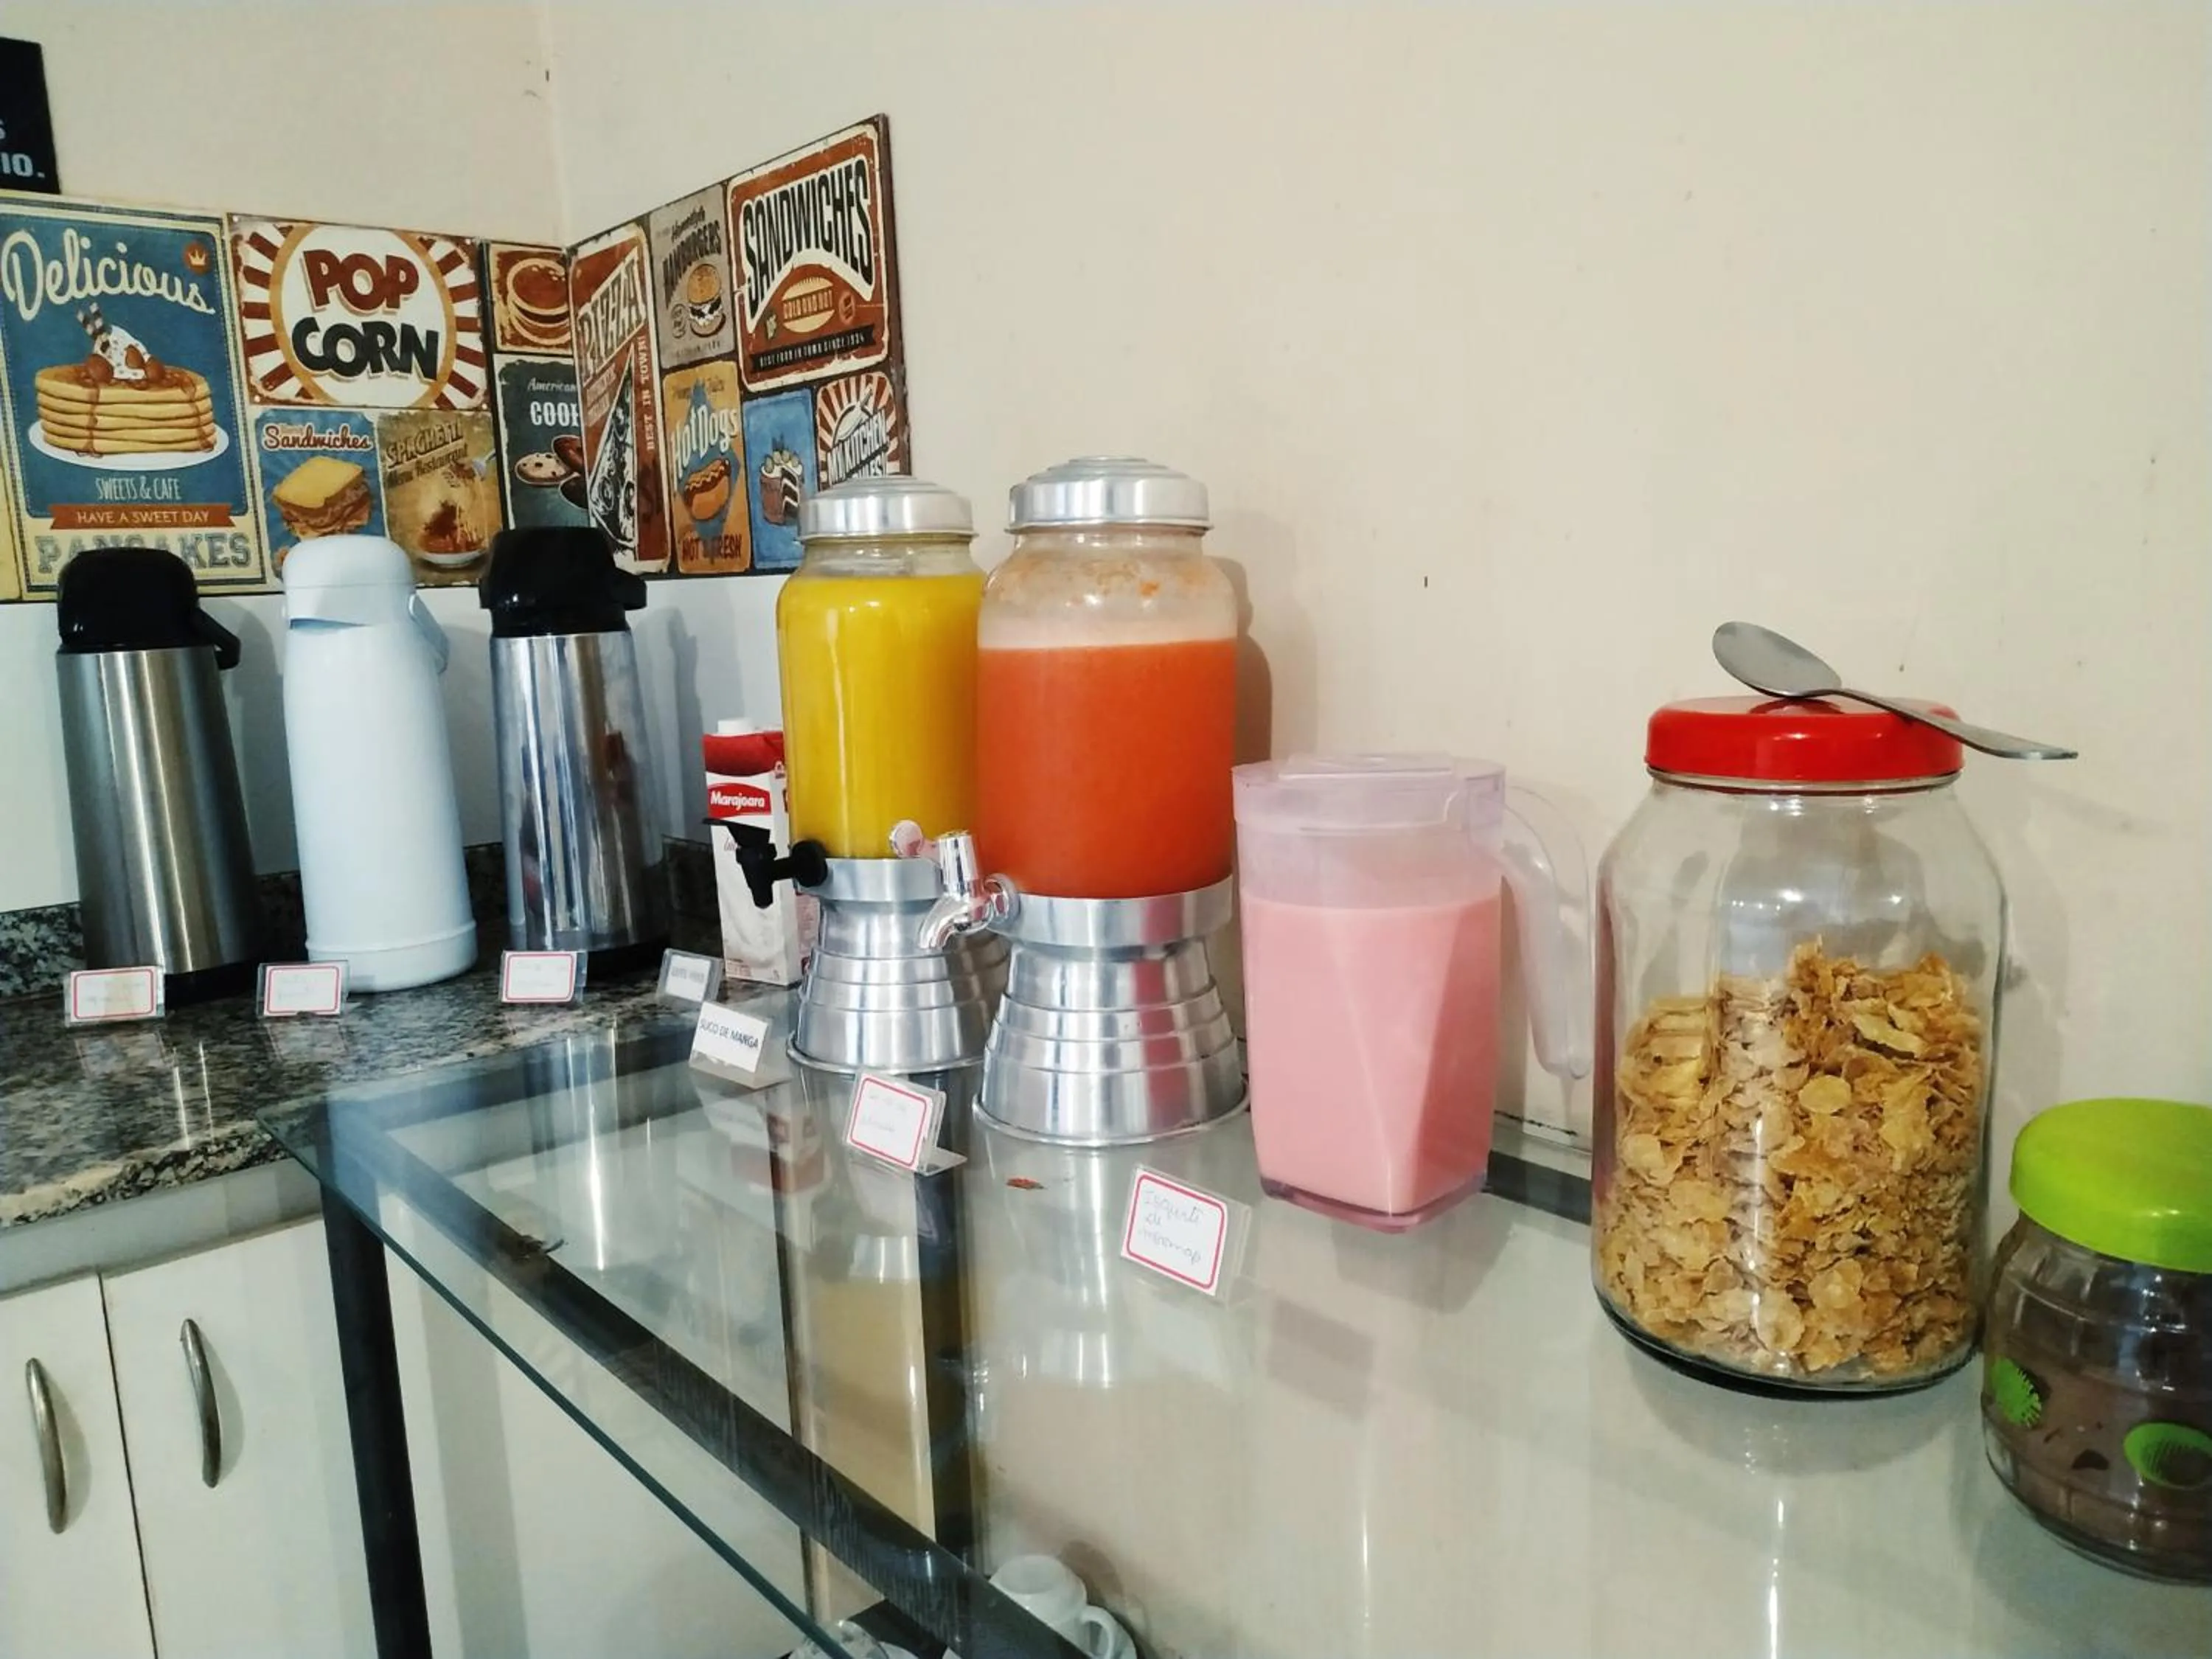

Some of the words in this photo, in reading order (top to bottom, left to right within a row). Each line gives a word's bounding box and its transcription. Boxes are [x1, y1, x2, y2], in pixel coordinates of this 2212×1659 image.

[742, 159, 874, 319] SANDWICHES
[1, 228, 215, 321] Delicious
[302, 249, 419, 313] POP
[578, 254, 644, 384] PIZZA
[292, 317, 439, 381] CORN
[641, 389, 651, 406] IN
[263, 423, 372, 450] Sandwiches
[95, 477, 138, 500] SWEETS
[139, 475, 152, 500] &
[153, 477, 181, 500] CAFE
[76, 511, 114, 524] HAVE
[119, 512, 129, 523] A
[131, 511, 178, 524] SWEET
[182, 510, 209, 523] DAY
[710, 790, 765, 811] Marajoara
[731, 1030, 759, 1048] MANGA
